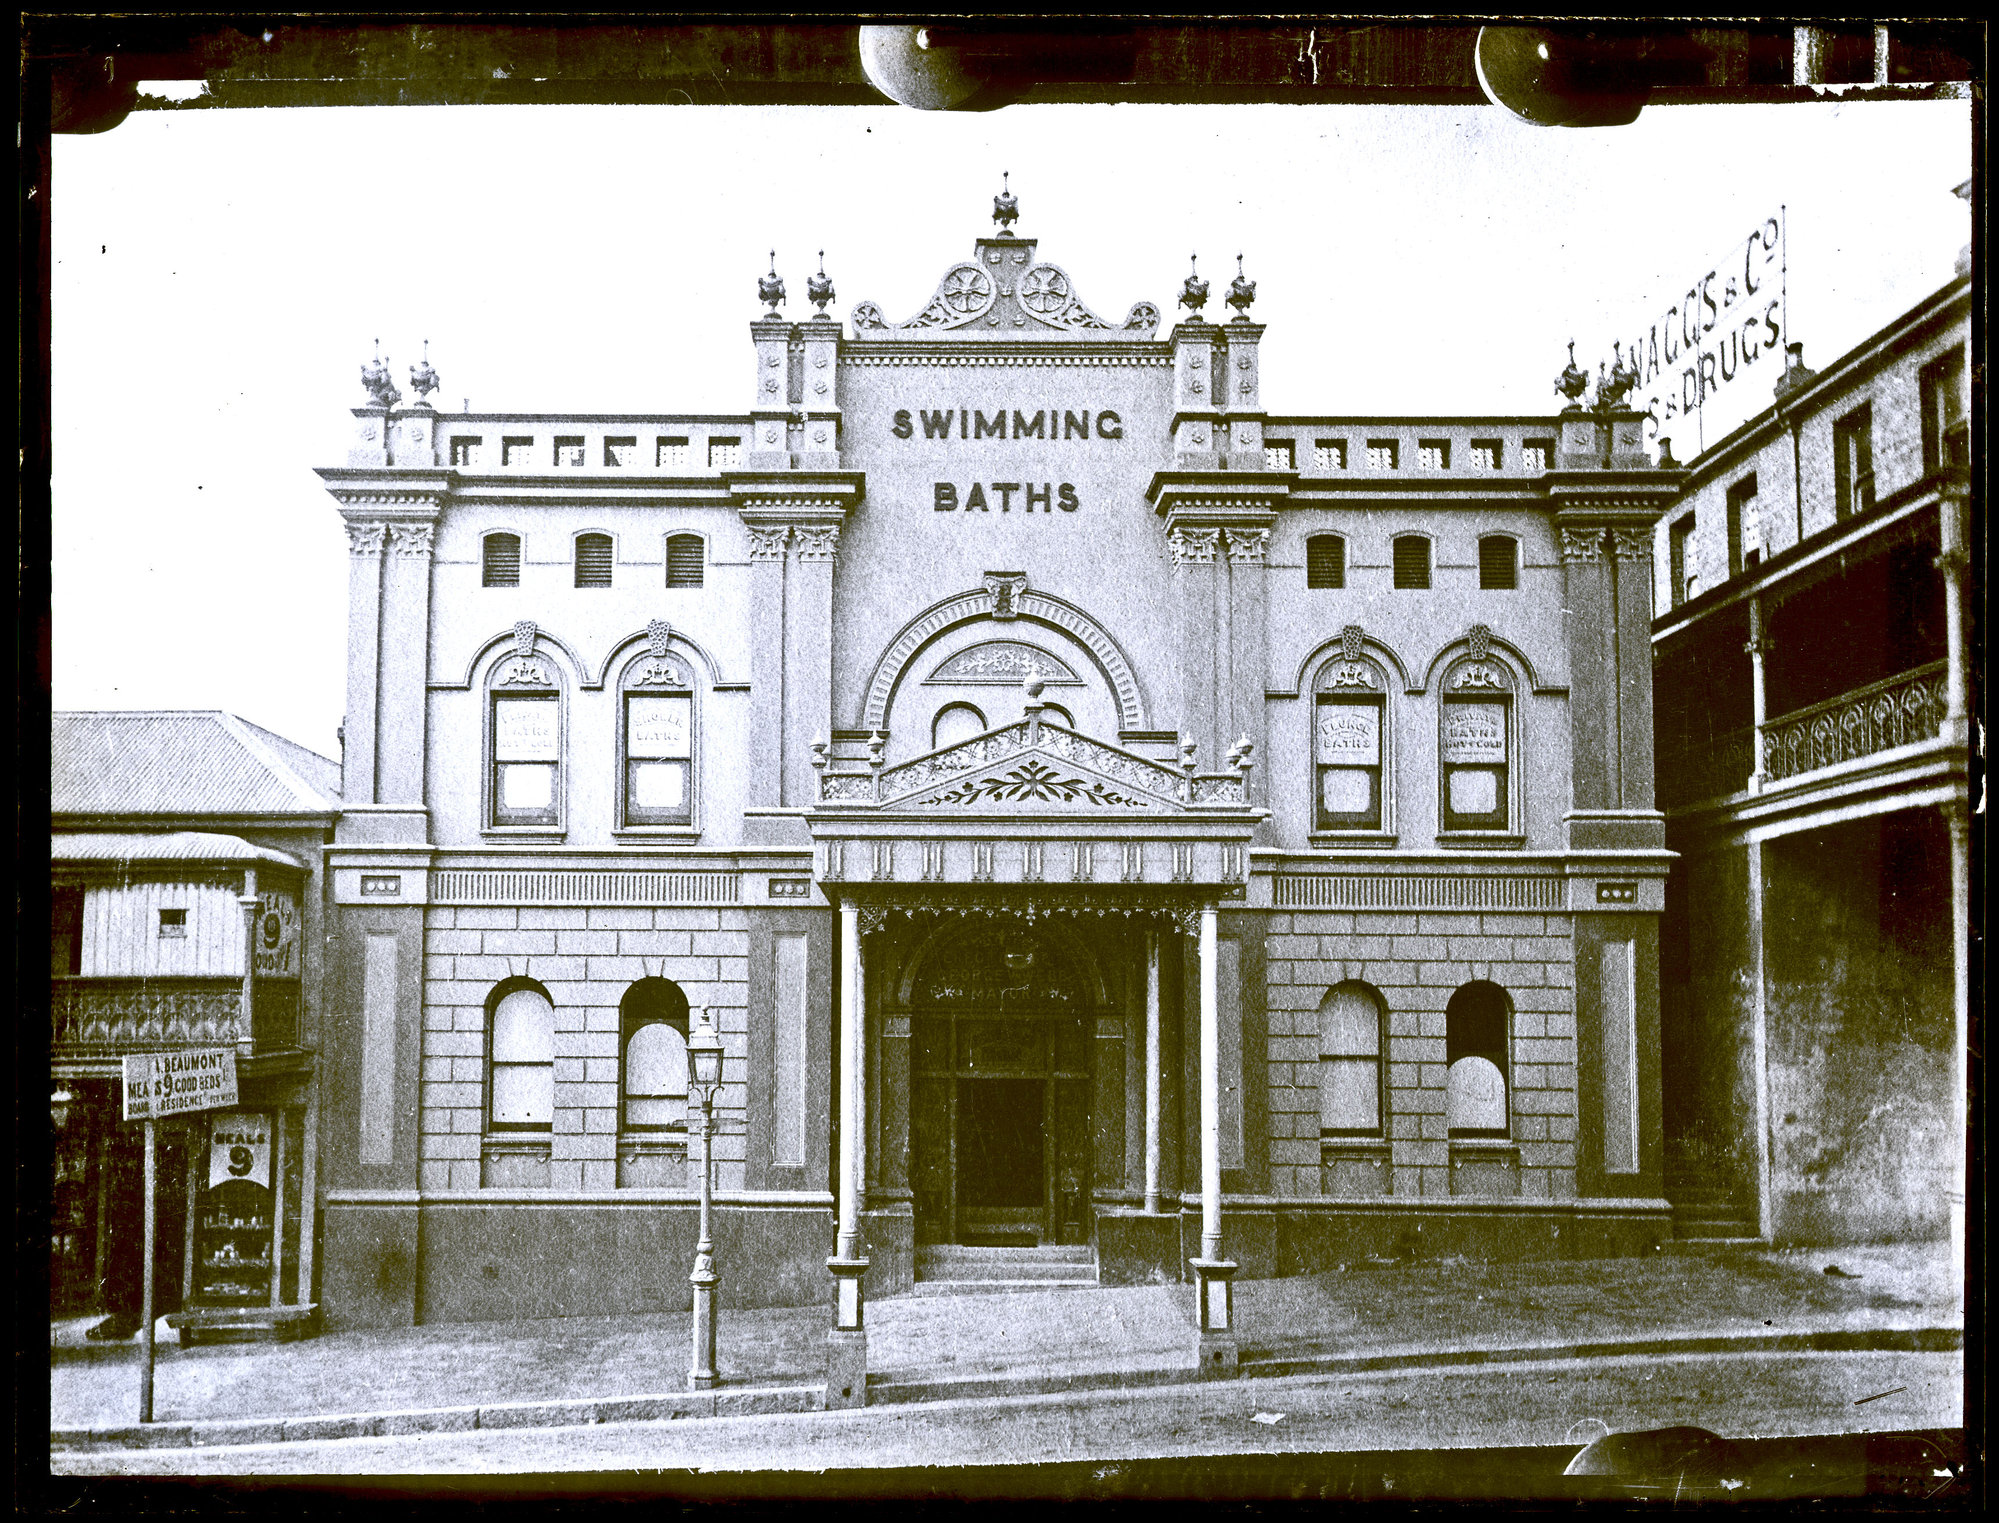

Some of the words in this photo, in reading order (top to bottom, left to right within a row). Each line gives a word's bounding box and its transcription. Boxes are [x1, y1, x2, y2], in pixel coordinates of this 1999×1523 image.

[1682, 300, 1780, 416] DRUGS
[891, 408, 1124, 440] SWIMMING
[933, 481, 1080, 513] BATHS
[263, 912, 281, 950] 9
[164, 1053, 224, 1073] BEAUMONT
[128, 1079, 162, 1099] MEAS
[163, 1073, 173, 1098] 9
[174, 1077, 198, 1093] GOOD
[160, 1094, 203, 1112] RESIDENCE
[214, 1132, 266, 1145] MEALS
[227, 1145, 255, 1177] 9
